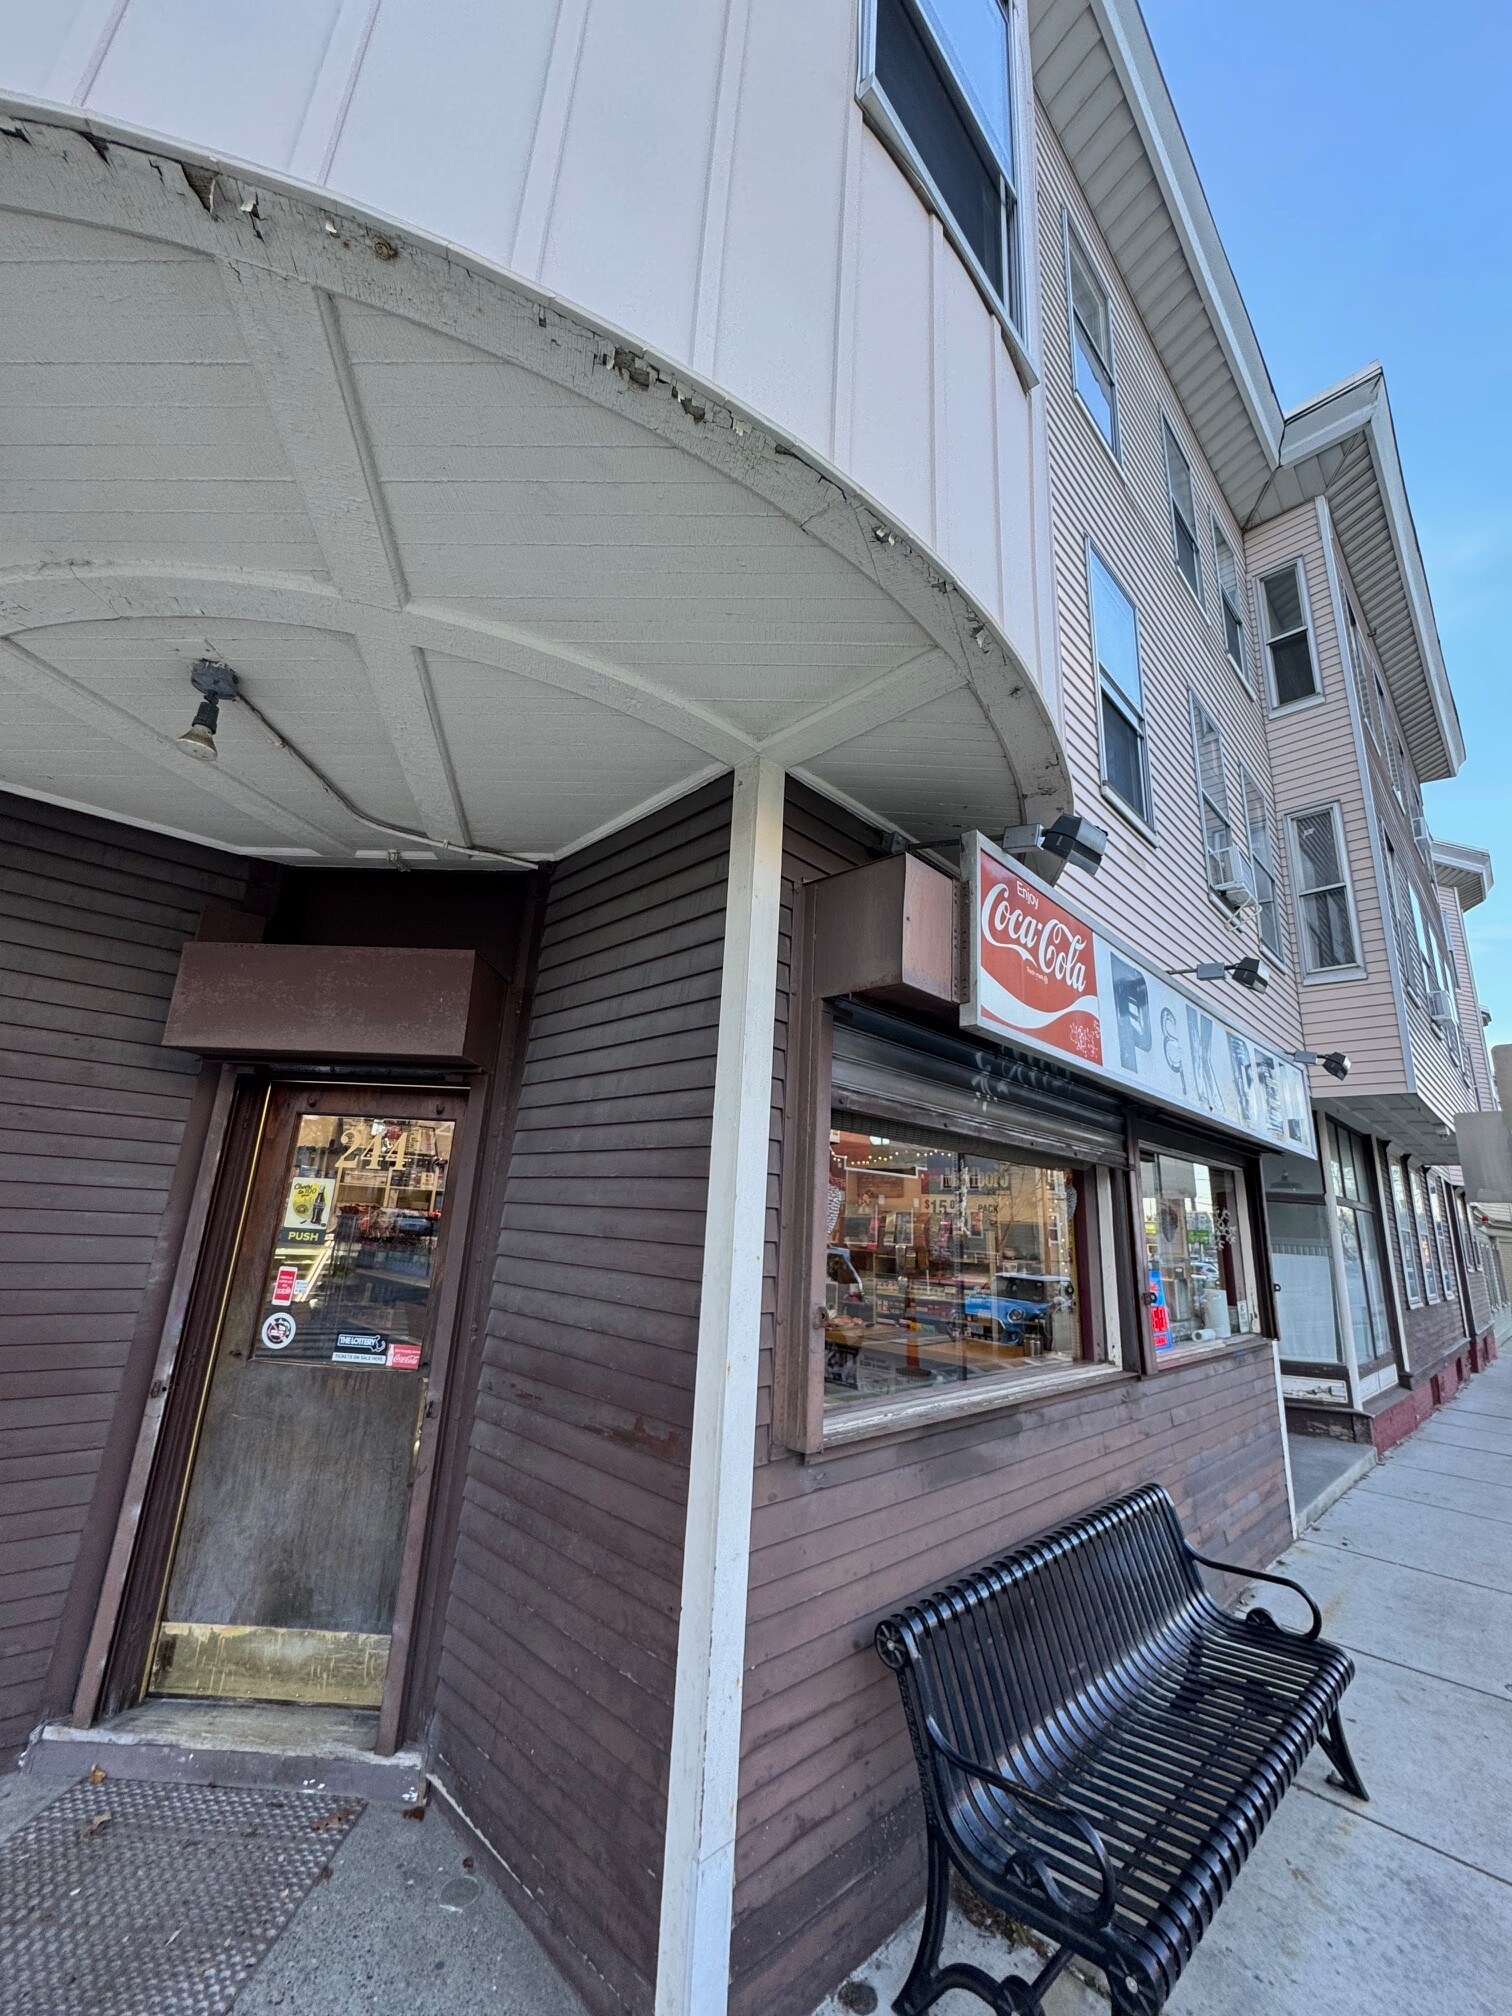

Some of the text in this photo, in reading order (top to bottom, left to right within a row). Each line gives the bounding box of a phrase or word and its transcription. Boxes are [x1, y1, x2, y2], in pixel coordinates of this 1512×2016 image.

[1016, 881, 1039, 910] Enjoy
[981, 883, 1087, 992] Coca-Cola
[335, 1130, 409, 1170] 244
[939, 1166, 1010, 1188] lboro
[288, 1231, 319, 1242] PUSH
[340, 1337, 375, 1346] THE LOTTERY
